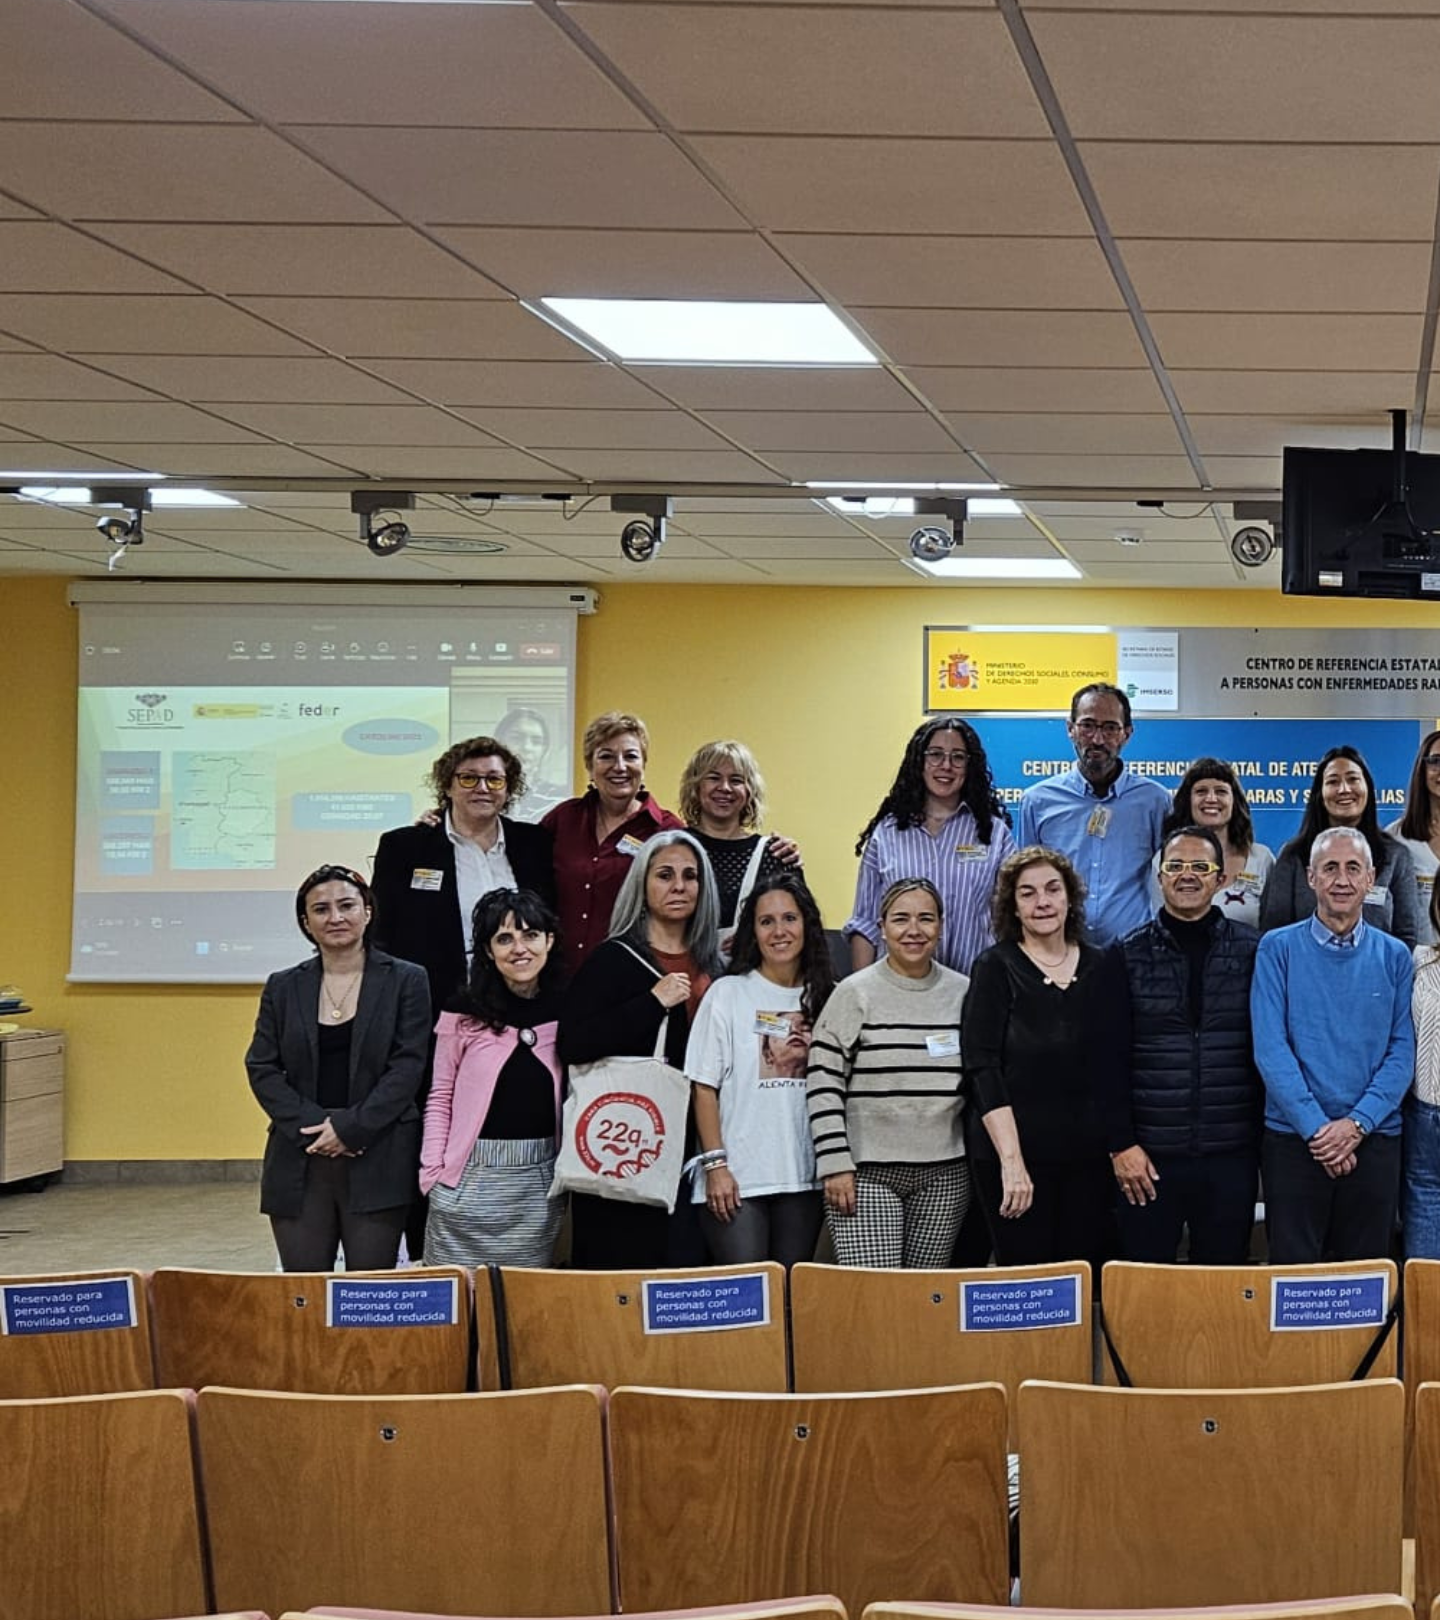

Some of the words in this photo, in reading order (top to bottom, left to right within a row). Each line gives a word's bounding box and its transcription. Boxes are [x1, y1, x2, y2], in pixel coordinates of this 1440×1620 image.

[1246, 658, 1295, 670] CENTRO
[1299, 659, 1314, 671] DE
[1316, 658, 1387, 671] REFERENCIA
[1220, 677, 1229, 689] A
[1232, 677, 1294, 690] PERSONAS
[1297, 678, 1322, 690] CON
[1326, 678, 1418, 690] ENFERMEDADES
[1140, 688, 1174, 696] IMSERSO
[127, 708, 174, 722] SEPAD
[298, 703, 340, 717] feder
[1023, 761, 1071, 776] CENTR
[1269, 762, 1288, 776] DE
[1246, 789, 1285, 804] ARAS
[1289, 789, 1299, 804] Y
[13, 1293, 72, 1304] Reservado
[76, 1292, 103, 1302] para
[340, 1289, 399, 1299] Reservado
[402, 1290, 427, 1300] para
[656, 1289, 712, 1299] Reservado
[715, 1287, 739, 1297] para
[972, 1290, 1027, 1300] Reservado
[1030, 1289, 1054, 1298] para
[1284, 1288, 1337, 1297] Reservado
[1340, 1287, 1362, 1297] para
[14, 1306, 66, 1317] personas
[69, 1305, 90, 1313] con
[340, 1302, 390, 1311] personas
[393, 1302, 414, 1310] con
[656, 1301, 704, 1312] personas
[708, 1300, 727, 1308] con
[973, 1303, 1020, 1313] personas
[1023, 1301, 1041, 1309] con
[1283, 1300, 1329, 1310] personas
[1332, 1300, 1350, 1308] con
[340, 1313, 394, 1322] movilidad
[397, 1312, 446, 1321] reducida
[656, 1311, 708, 1322] movilidad
[712, 1308, 757, 1320] reducida
[973, 1313, 1023, 1324] movilidad
[1026, 1309, 1070, 1321] reducida
[1282, 1311, 1331, 1320] movilidad
[1334, 1308, 1377, 1319] reducida
[16, 1316, 70, 1328] movilidad
[73, 1313, 123, 1324] reducida
